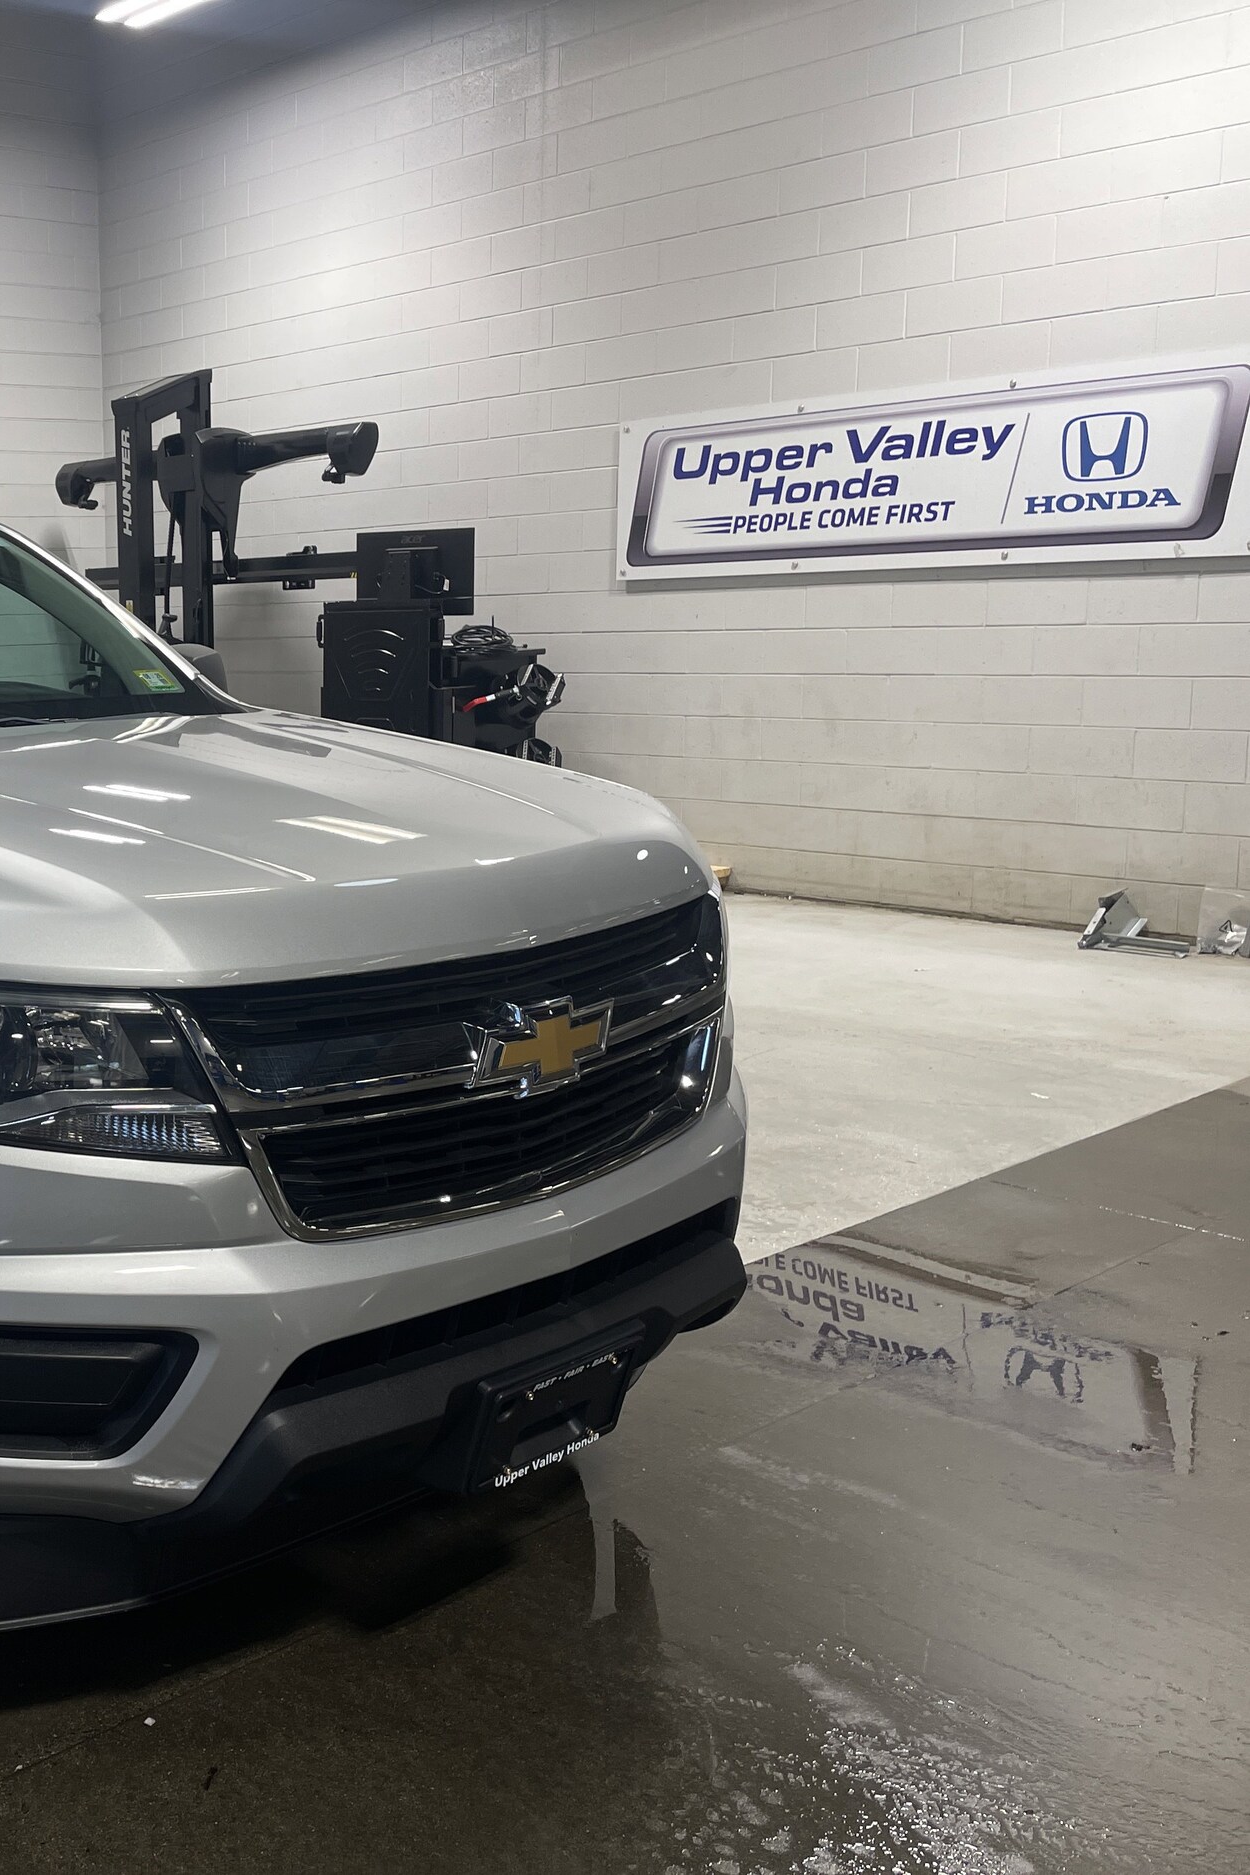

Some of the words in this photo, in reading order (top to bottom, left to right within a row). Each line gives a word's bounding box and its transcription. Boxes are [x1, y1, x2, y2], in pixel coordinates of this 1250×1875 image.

[673, 441, 834, 485] Upper
[846, 419, 1016, 464] Valley
[121, 428, 133, 537] HUNTER
[748, 467, 900, 507] Honda
[1024, 487, 1181, 515] HONDA
[732, 510, 813, 535] PEOPLE
[817, 505, 881, 529] COME
[885, 500, 956, 525] FIRST
[400, 534, 427, 544] acer
[532, 1376, 557, 1393] FAST
[563, 1365, 585, 1380] FAIR
[494, 1465, 530, 1488] Upper
[532, 1449, 565, 1471] Valley
[566, 1432, 600, 1455] Honda
